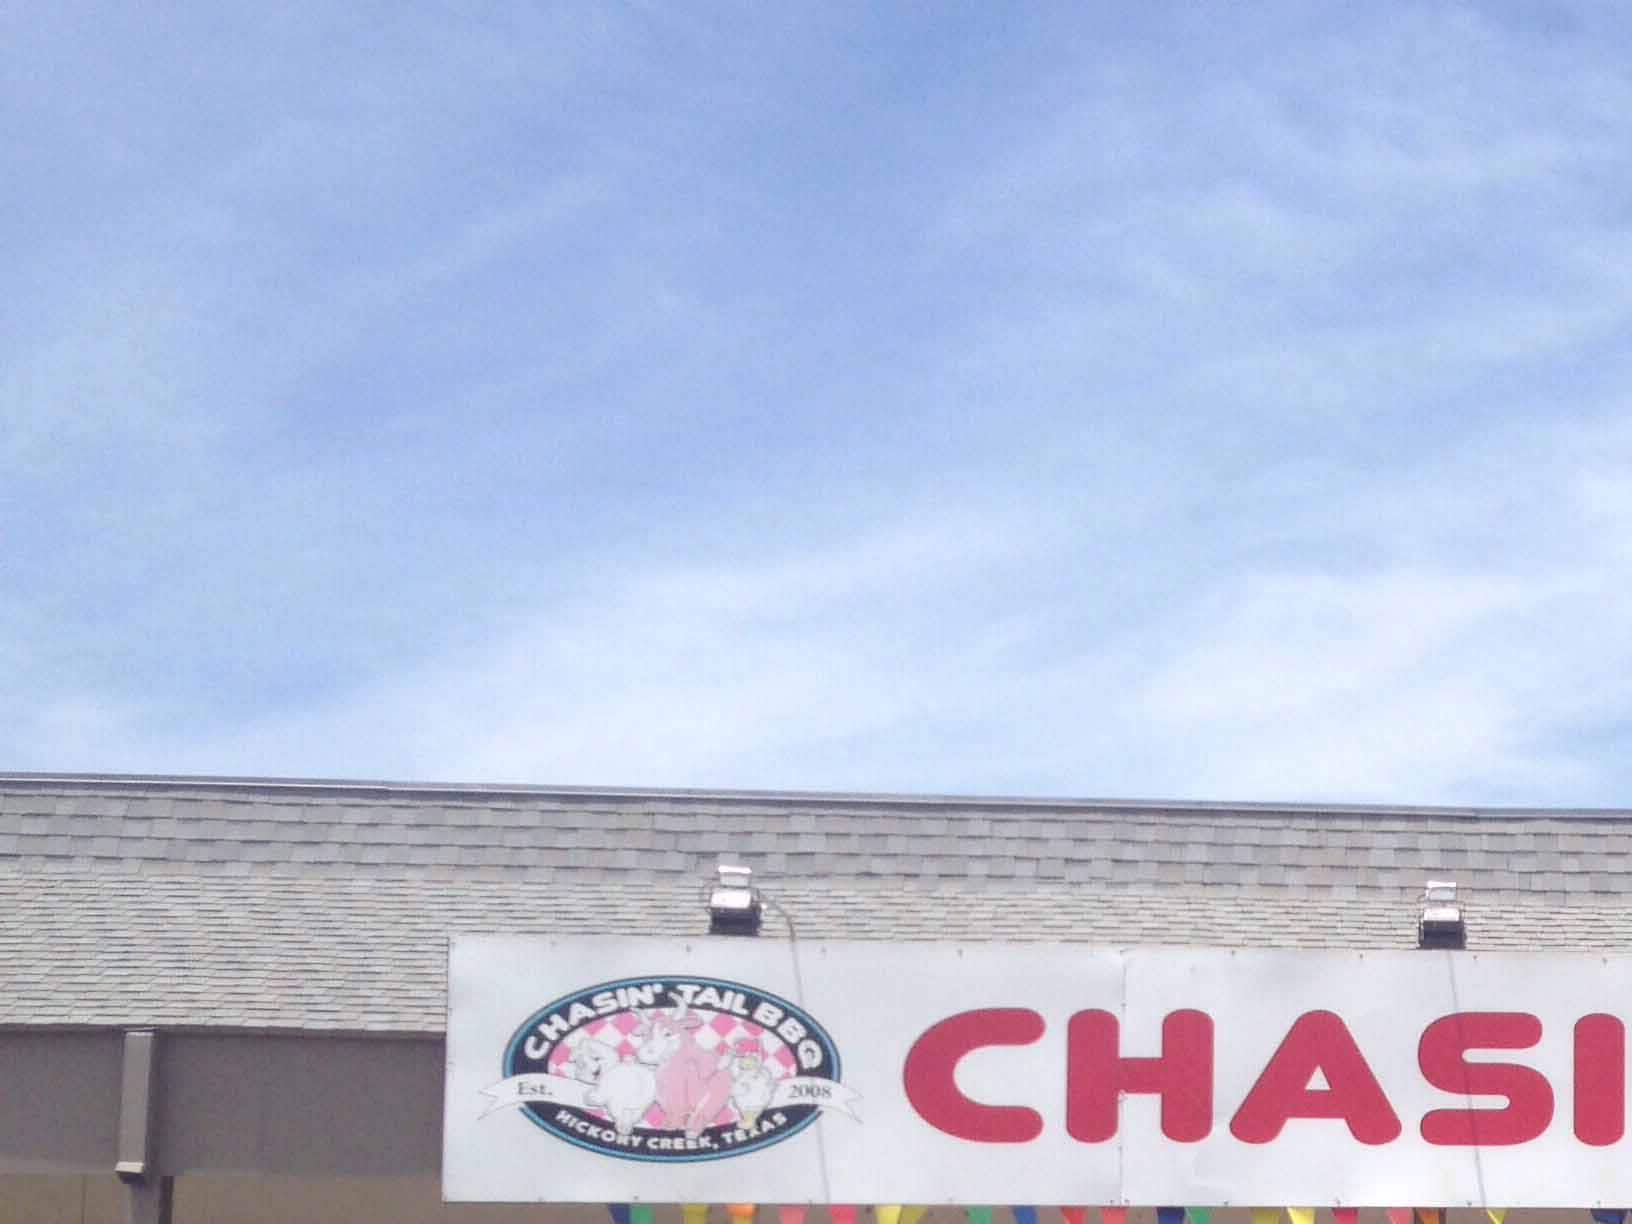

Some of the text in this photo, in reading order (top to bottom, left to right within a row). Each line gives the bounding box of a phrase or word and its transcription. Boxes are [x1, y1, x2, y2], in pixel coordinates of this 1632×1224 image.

[523, 983, 824, 1069] CHASIN' TAIL BBQ
[787, 1083, 833, 1099] 2008
[722, 1111, 788, 1143] TEXAS
